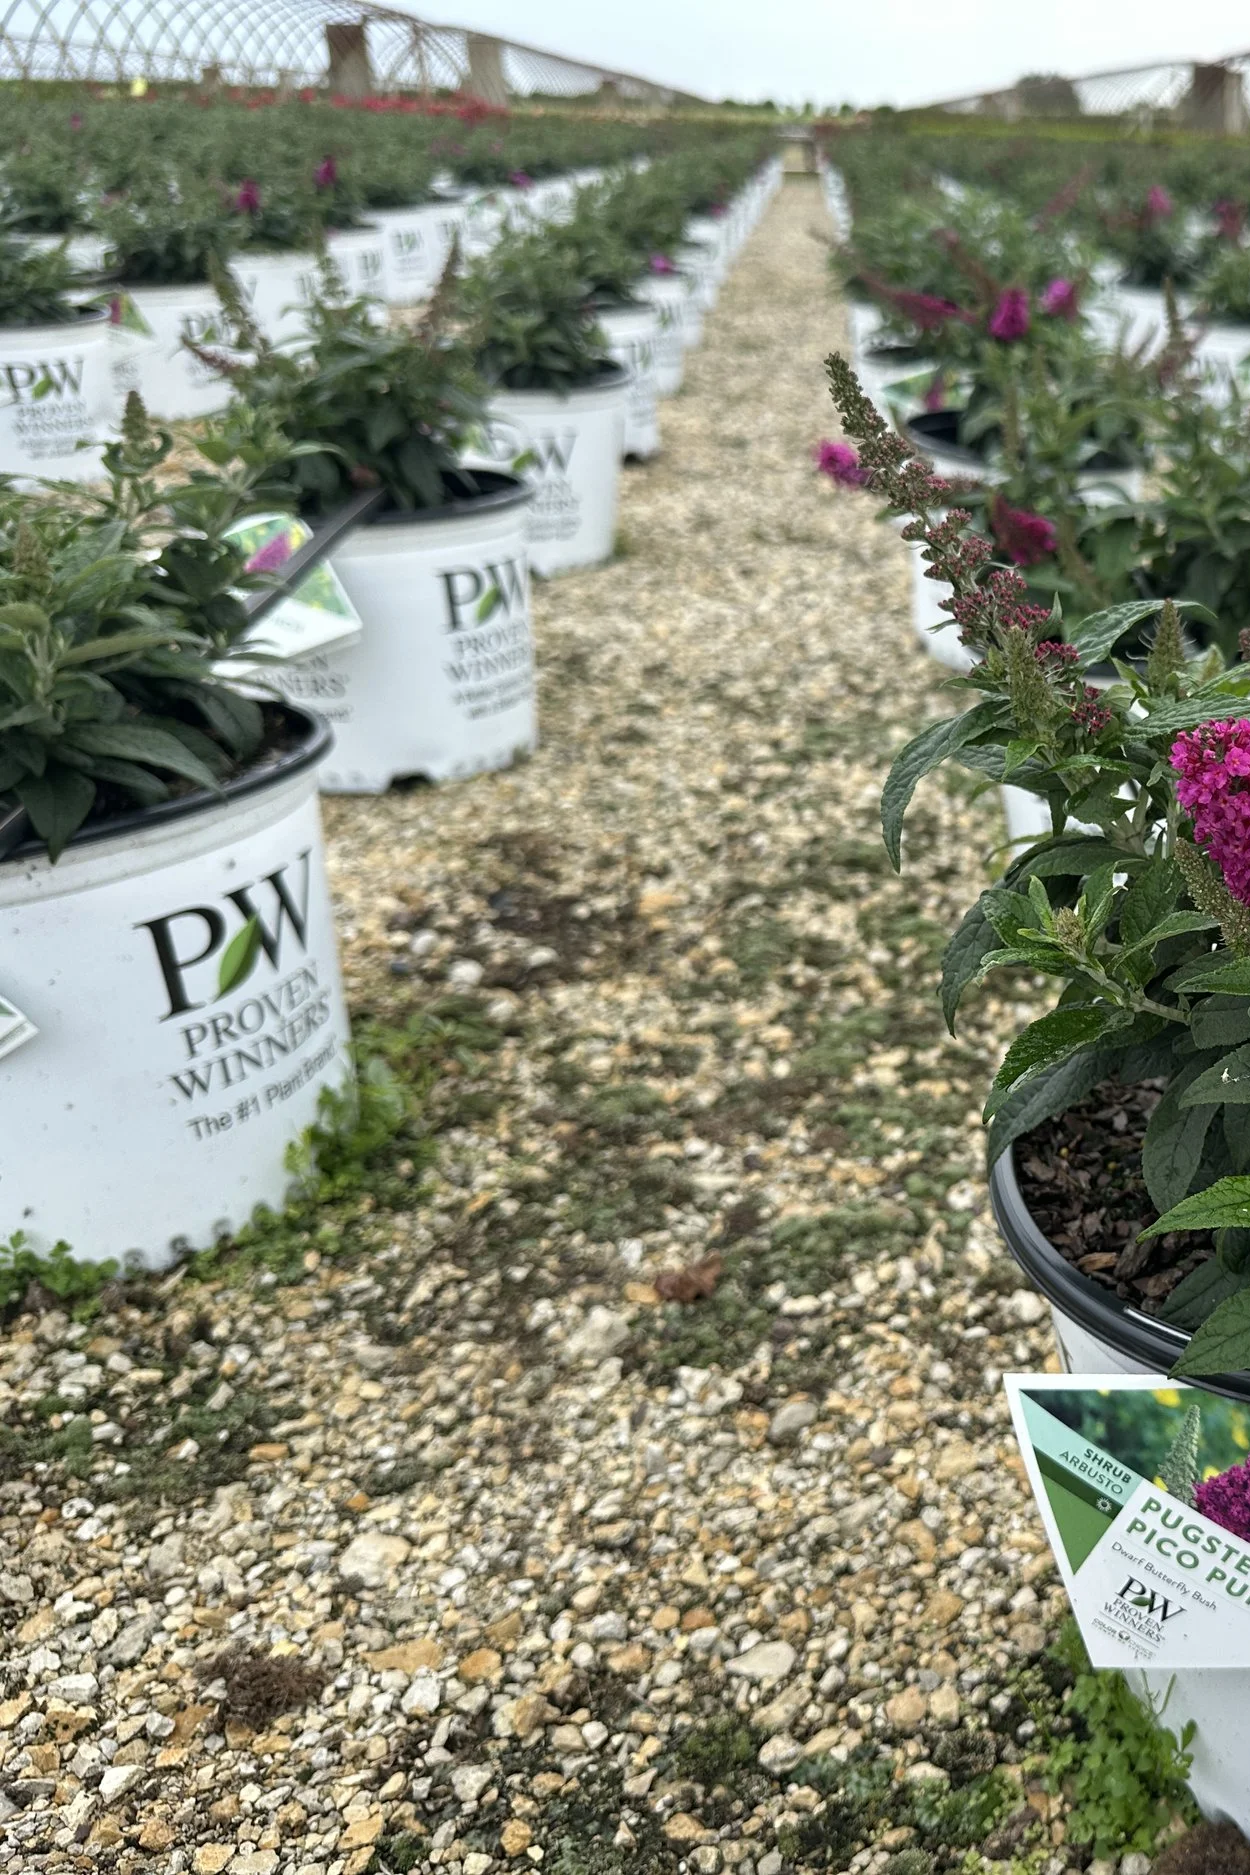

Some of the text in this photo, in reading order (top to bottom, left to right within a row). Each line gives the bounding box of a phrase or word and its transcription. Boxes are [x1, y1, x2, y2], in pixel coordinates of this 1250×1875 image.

[434, 551, 528, 633] PW
[133, 847, 312, 1023] PW
[180, 959, 319, 1060] PROVEN
[167, 987, 331, 1101] WINNERS
[186, 1111, 233, 1141] The
[234, 1094, 261, 1126] #1
[1058, 1450, 1124, 1496] ARBUSTO
[1084, 1447, 1133, 1484] SHRUB
[1125, 1516, 1201, 1570] PICO
[1111, 1540, 1219, 1613] Dwarf Butterfly Bush
[1115, 1574, 1188, 1622] PW
[1112, 1598, 1165, 1632] PROVEN
